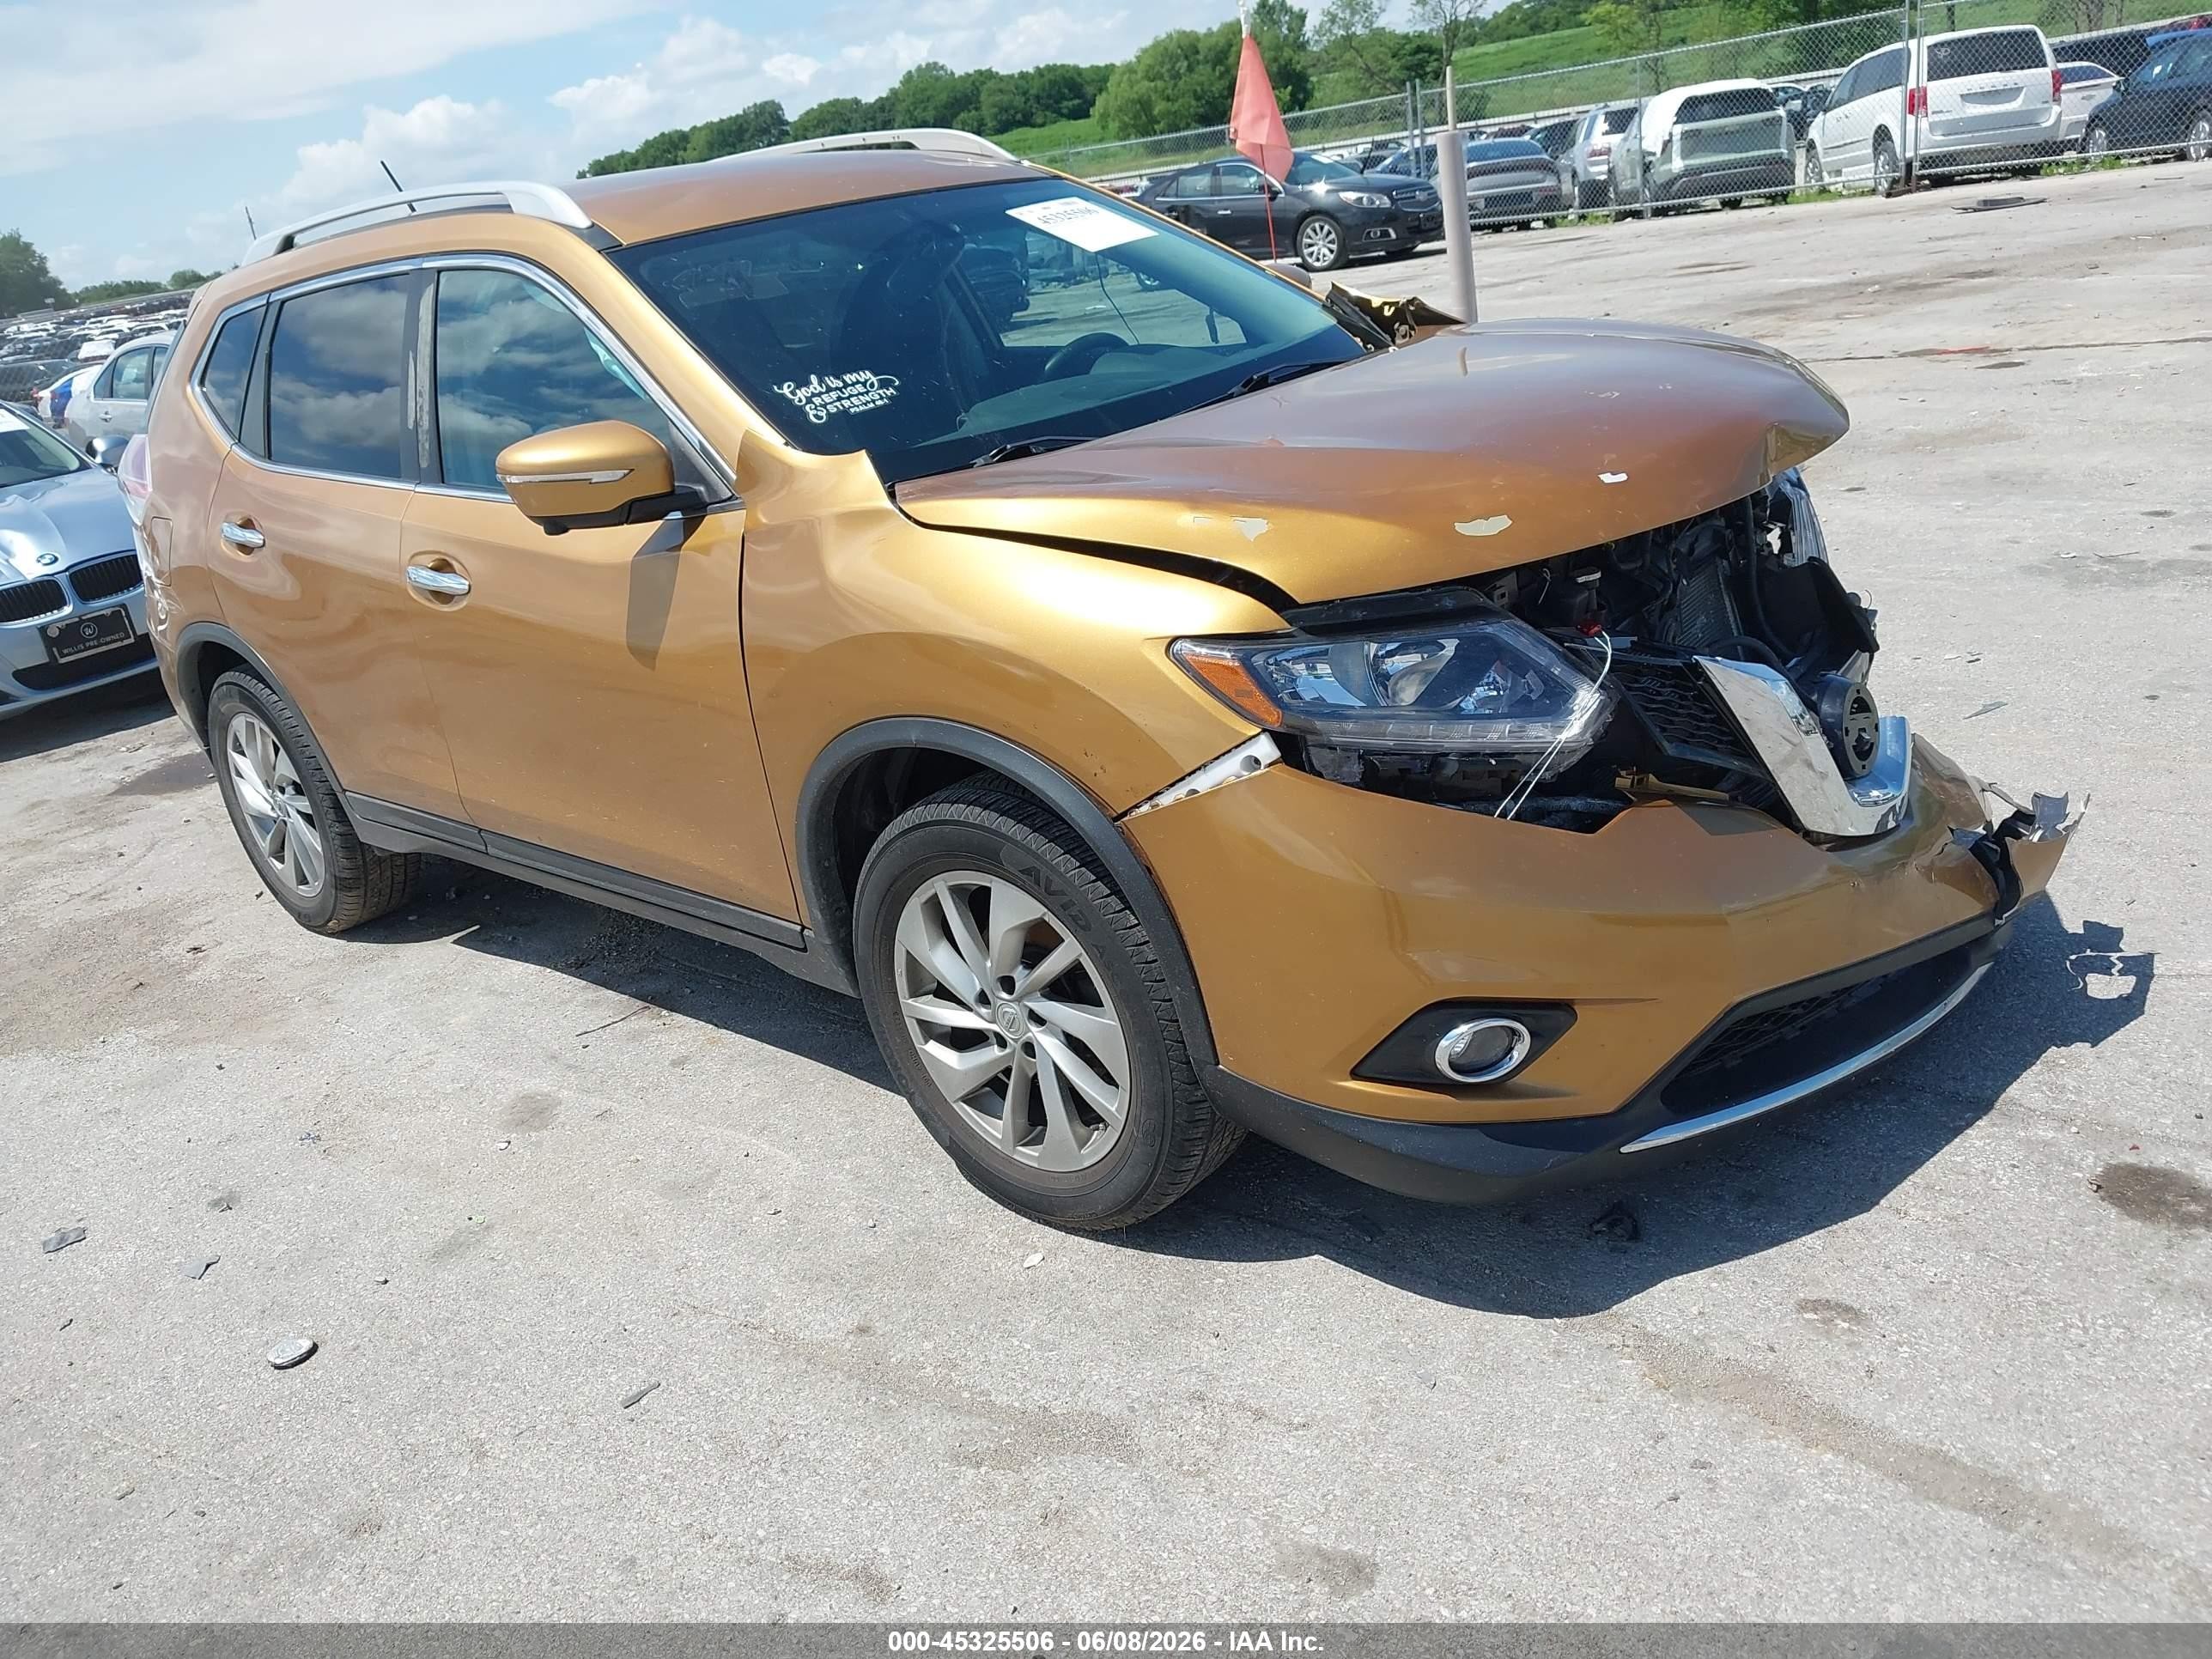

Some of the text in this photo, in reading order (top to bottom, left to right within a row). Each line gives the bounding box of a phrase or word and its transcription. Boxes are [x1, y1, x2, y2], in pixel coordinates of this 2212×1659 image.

[773, 370, 899, 405] God is my
[811, 383, 867, 406] REFUGE
[805, 386, 897, 423] & STRENGTH
[848, 401, 875, 413] PSALM
[61, 643, 84, 655] WILLIS
